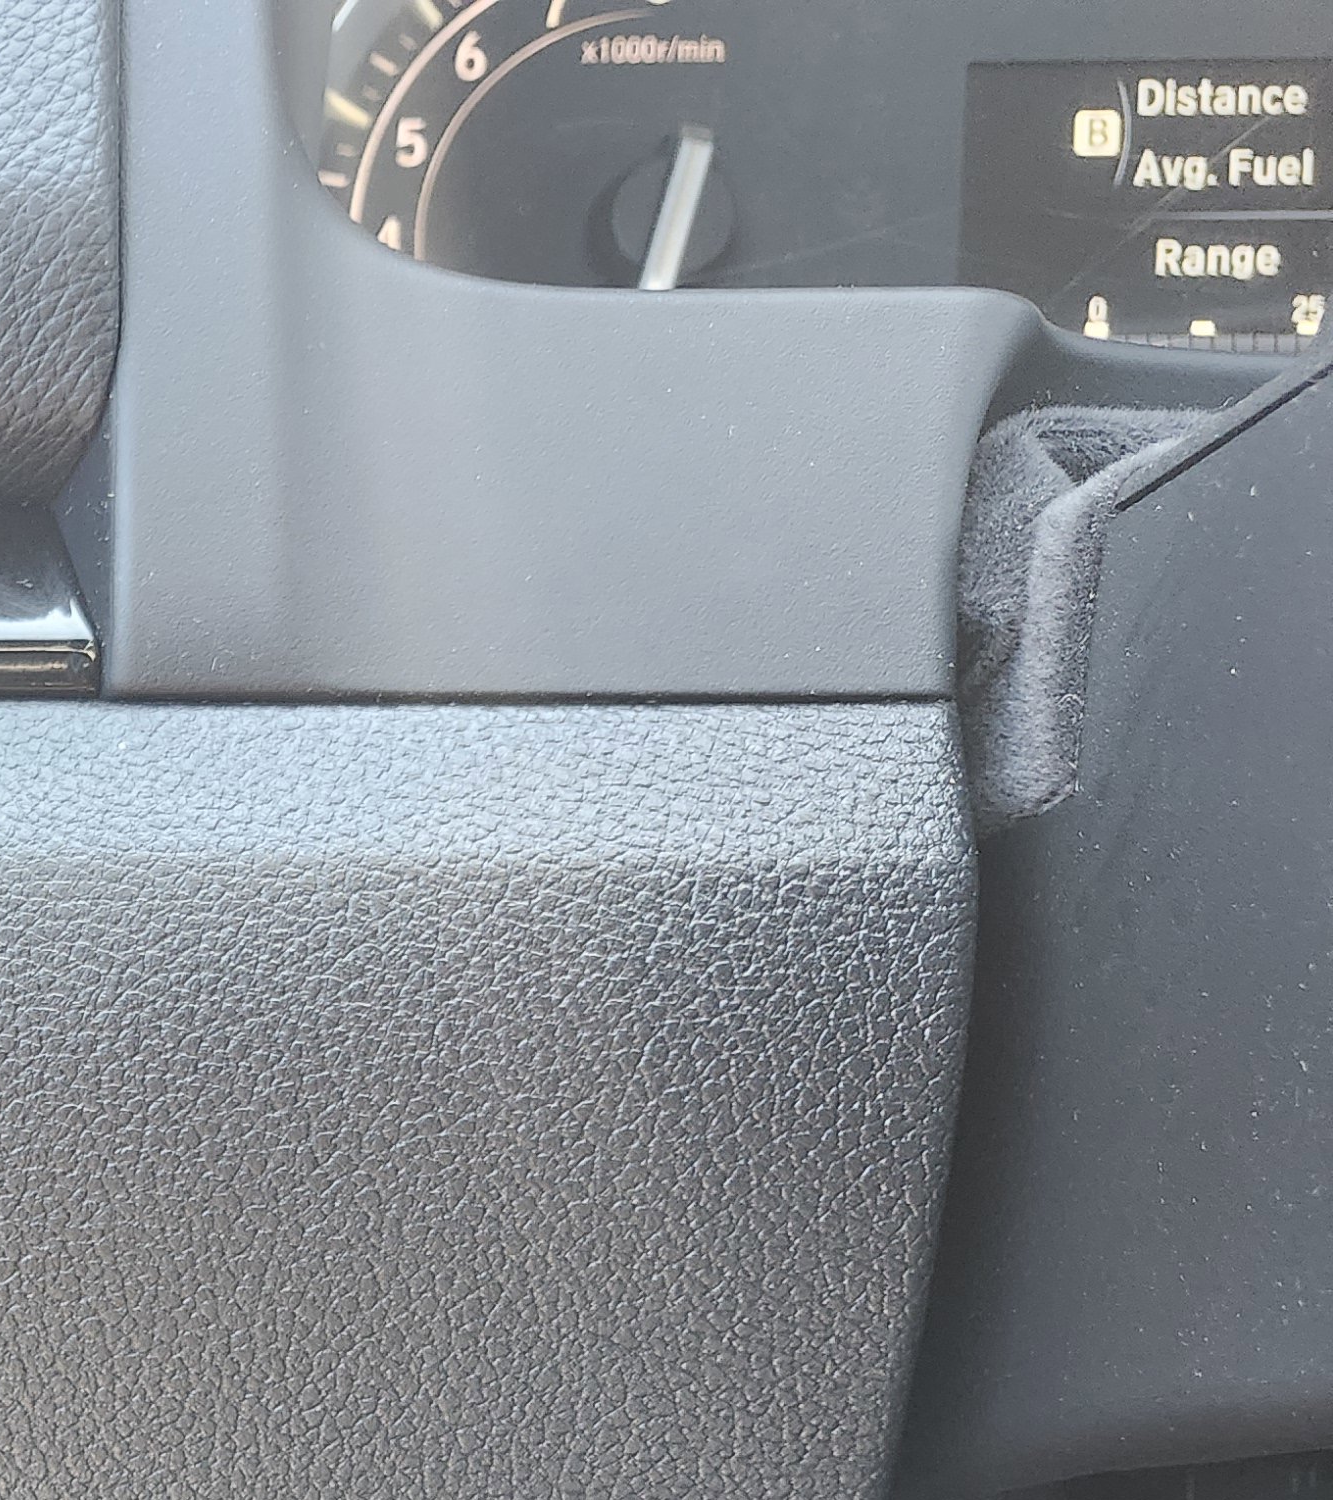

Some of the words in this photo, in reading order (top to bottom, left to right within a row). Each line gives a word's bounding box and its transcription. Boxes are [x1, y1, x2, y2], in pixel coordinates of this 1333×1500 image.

[454, 31, 488, 83] 6
[1136, 77, 1309, 117] Distance
[395, 117, 428, 168] 5
[1088, 120, 1108, 147] B
[1132, 148, 1219, 191] Avg.
[1228, 147, 1315, 187] Fuel
[1154, 238, 1282, 281] Range
[1088, 295, 1108, 323] 0
